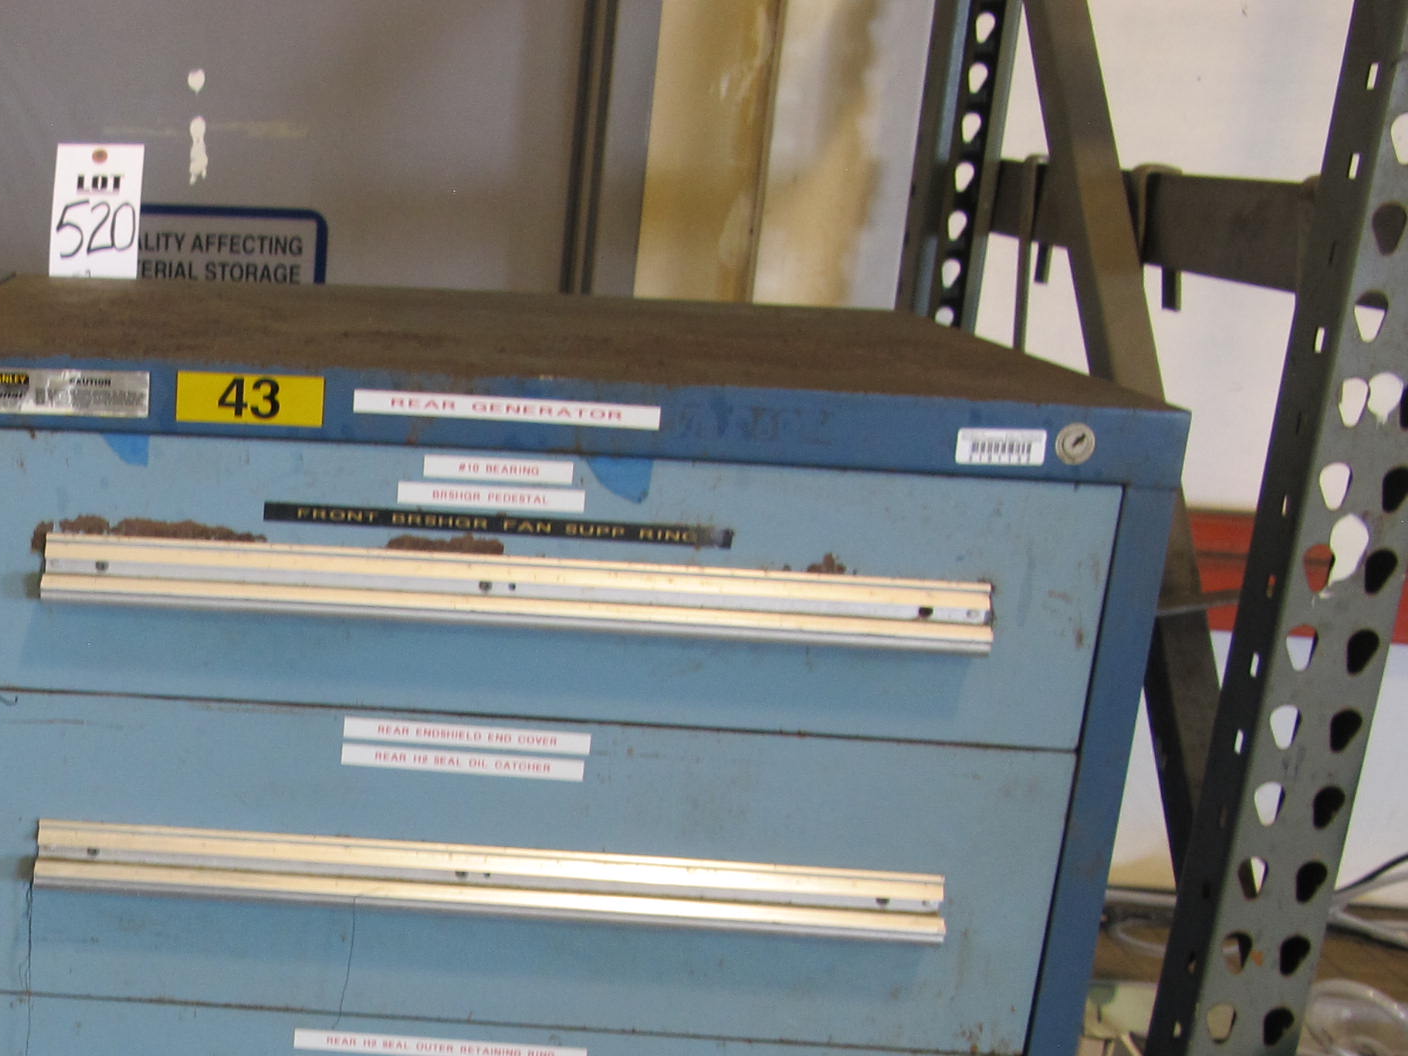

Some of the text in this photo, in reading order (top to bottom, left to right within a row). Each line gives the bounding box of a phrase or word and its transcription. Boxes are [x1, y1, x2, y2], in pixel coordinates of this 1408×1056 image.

[77, 174, 124, 195] LOT
[56, 199, 136, 259] 520
[139, 231, 303, 256] LITY AFFECTING
[138, 261, 301, 284] ERIAL STORAGE
[217, 375, 282, 421] 43
[390, 398, 623, 421] REAR GENERATOR
[485, 464, 540, 476] BEARING
[487, 492, 548, 504] PEDESTAL
[296, 508, 379, 526] FRONT
[392, 513, 489, 532] BRSHGR
[502, 519, 552, 535] FAN
[565, 522, 626, 539] SUPP
[376, 724, 558, 746] REAR ENDSHIELD END COVER
[374, 752, 407, 763] REAR
[433, 755, 462, 767] SEAL
[468, 758, 488, 769] OIL
[494, 759, 551, 773] CATCHER
[326, 1036, 357, 1048] REAR
[382, 1039, 410, 1051] SEAL
[415, 1041, 454, 1054] OUTER
